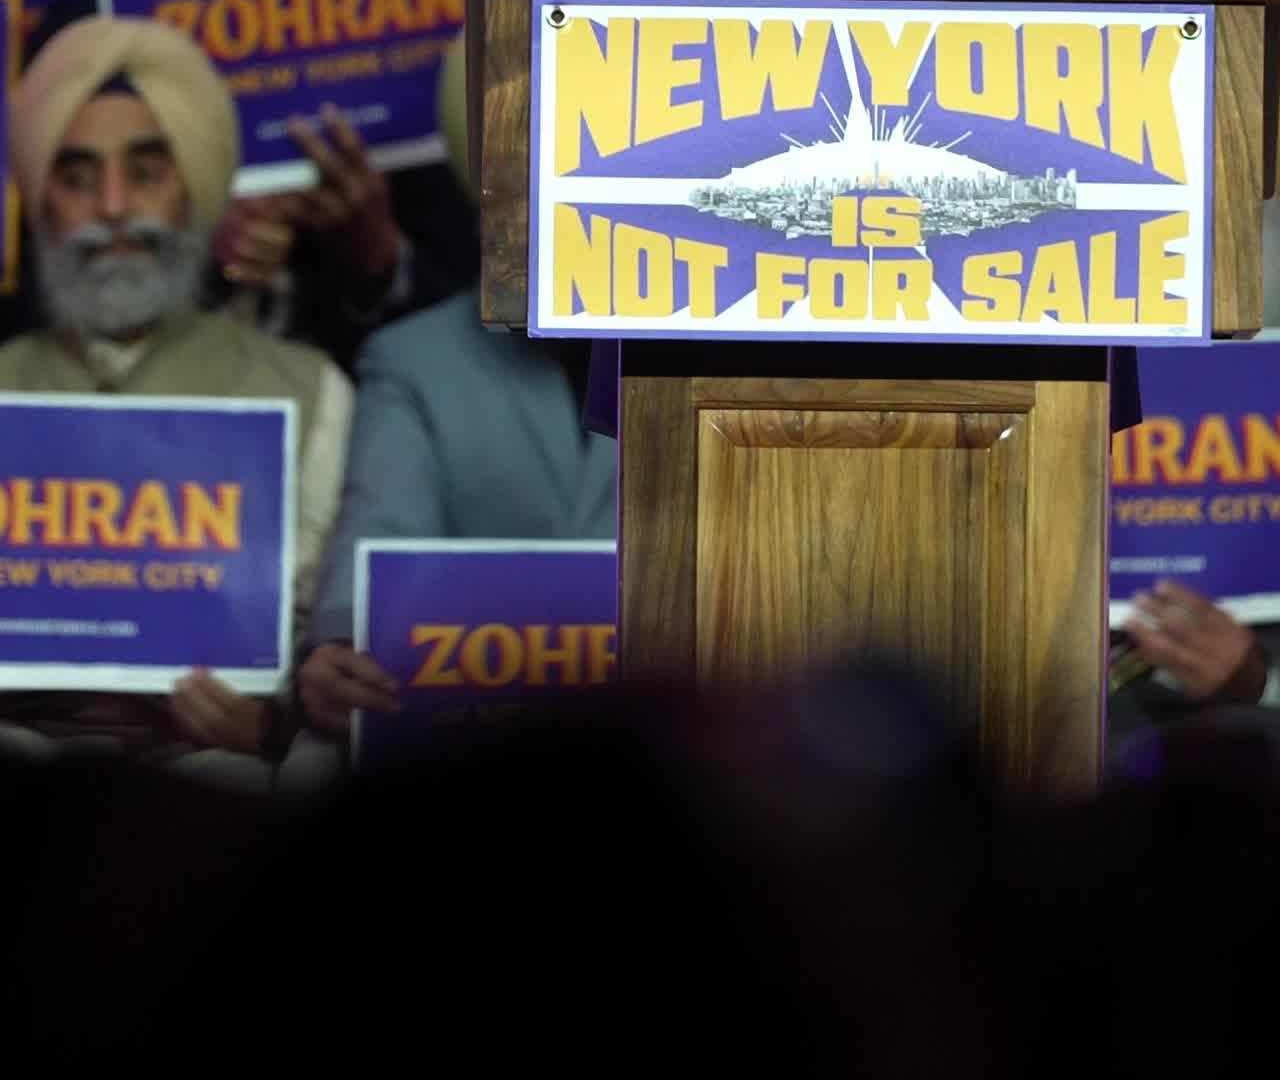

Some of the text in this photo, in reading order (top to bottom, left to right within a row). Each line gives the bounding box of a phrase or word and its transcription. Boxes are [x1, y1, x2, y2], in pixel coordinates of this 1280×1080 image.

[554, 16, 1189, 185] NEW YORK
[831, 195, 922, 248] IS
[552, 202, 728, 318] NOT
[755, 252, 933, 320] FOR
[961, 210, 1190, 325] SALE
[1113, 494, 1202, 526] YORK
[46, 558, 139, 591] YORK
[143, 560, 224, 593] CITY
